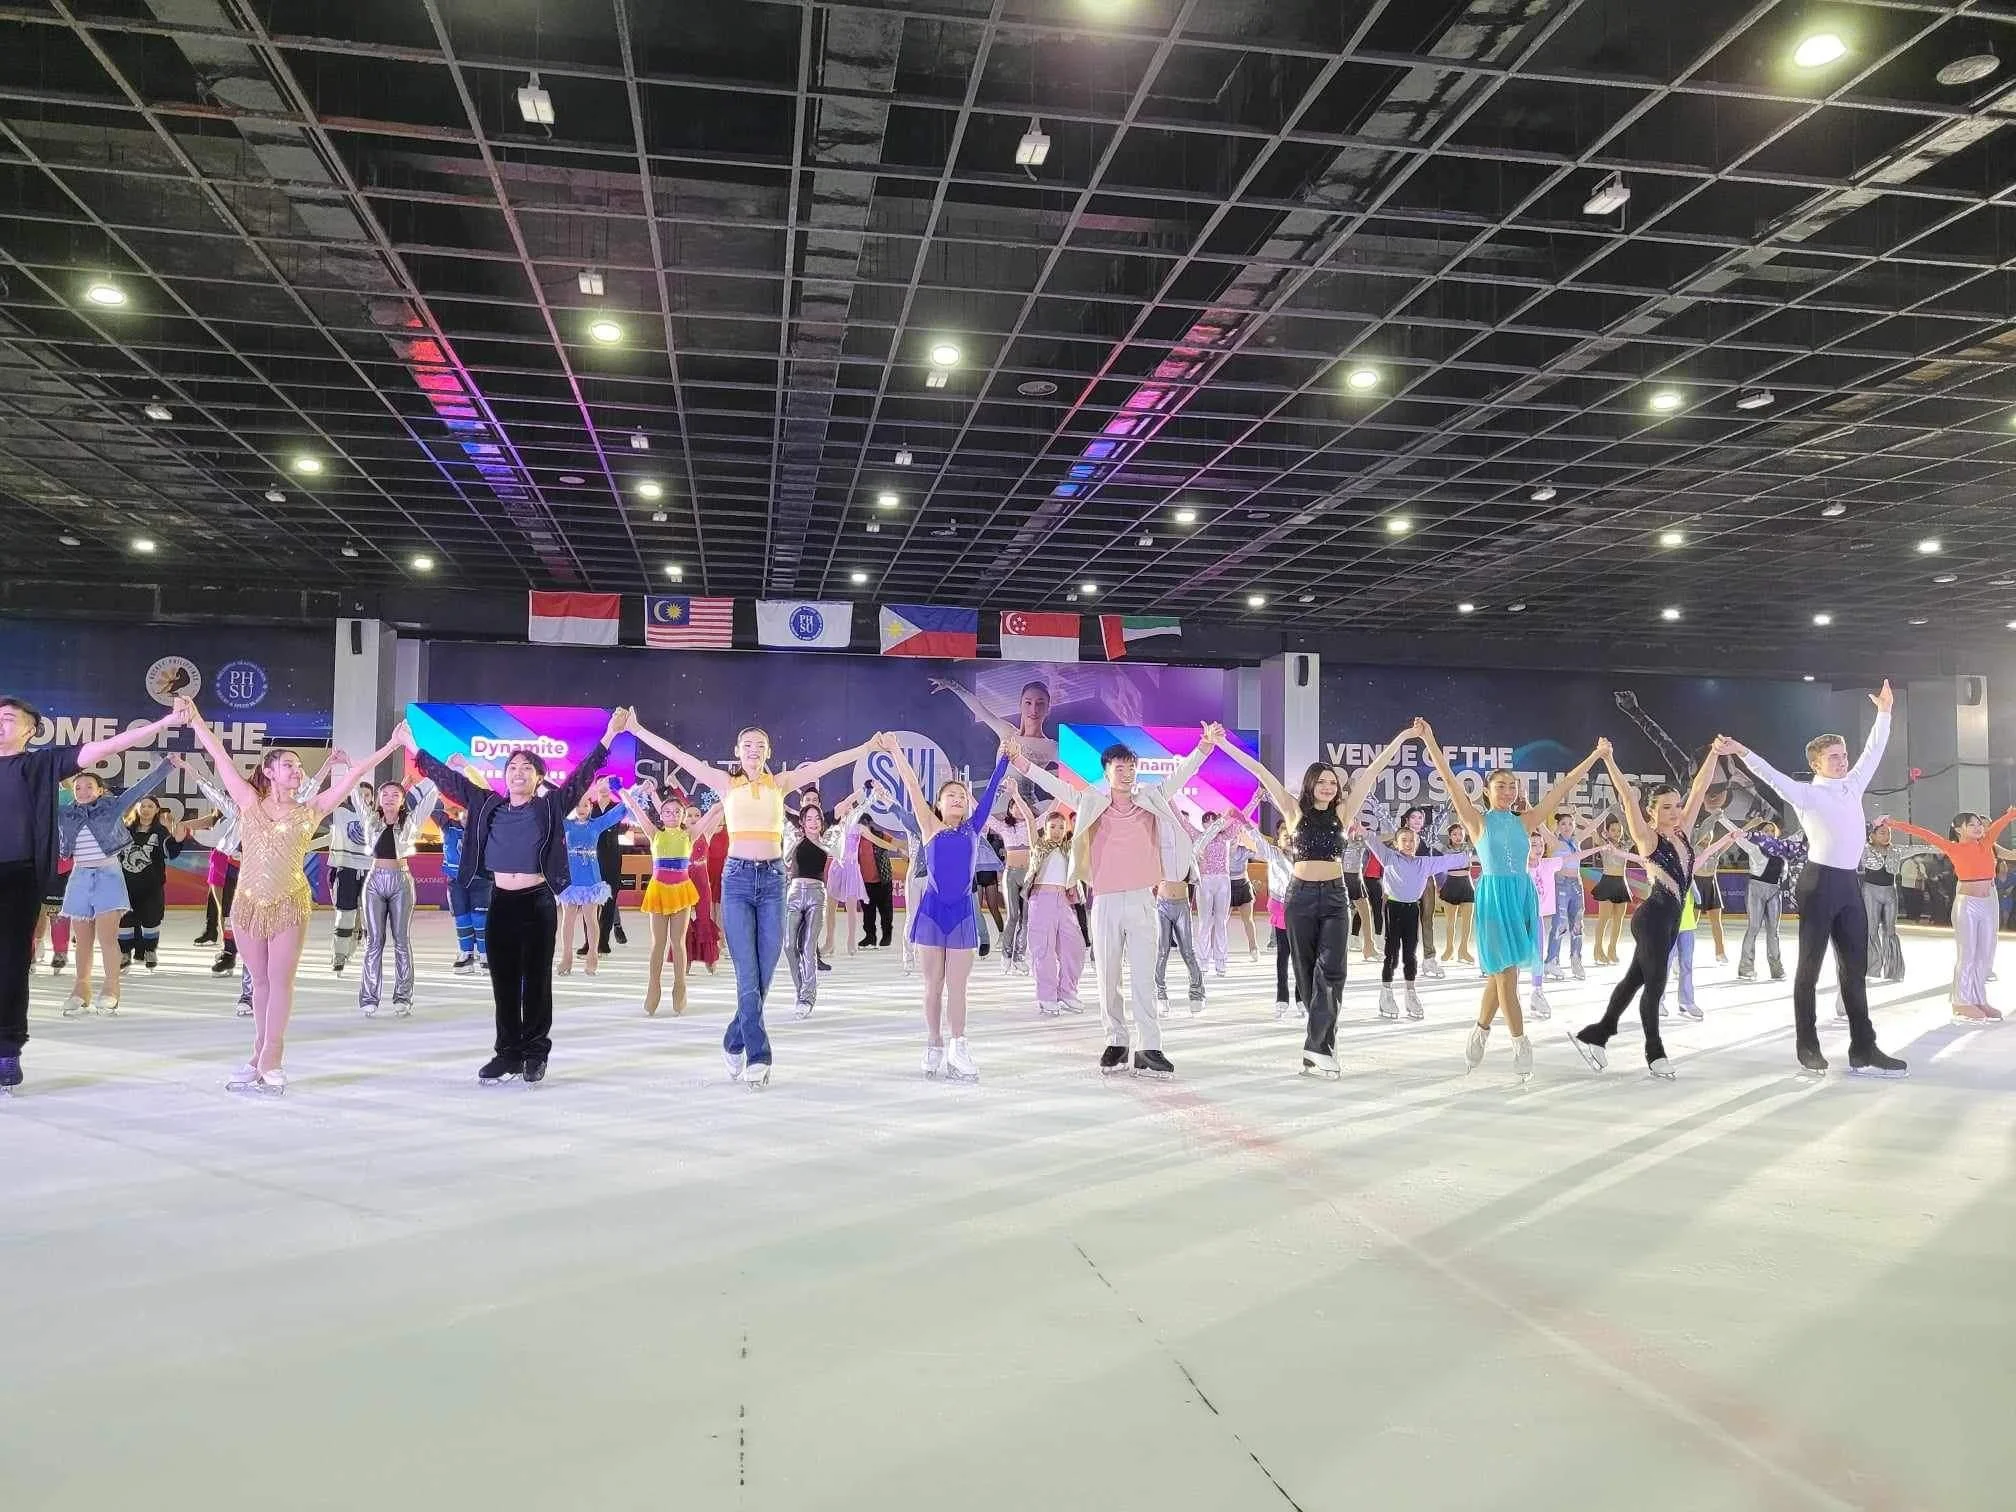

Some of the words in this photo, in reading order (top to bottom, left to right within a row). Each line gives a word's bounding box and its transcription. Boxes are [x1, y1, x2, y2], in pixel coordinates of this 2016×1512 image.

[800, 614, 813, 624] PH
[800, 623, 813, 633] SU
[230, 671, 254, 685] PH
[229, 685, 253, 698] SU
[29, 716, 118, 746] OME
[474, 739, 565, 758] Dynamite
[1460, 746, 1513, 768] THE
